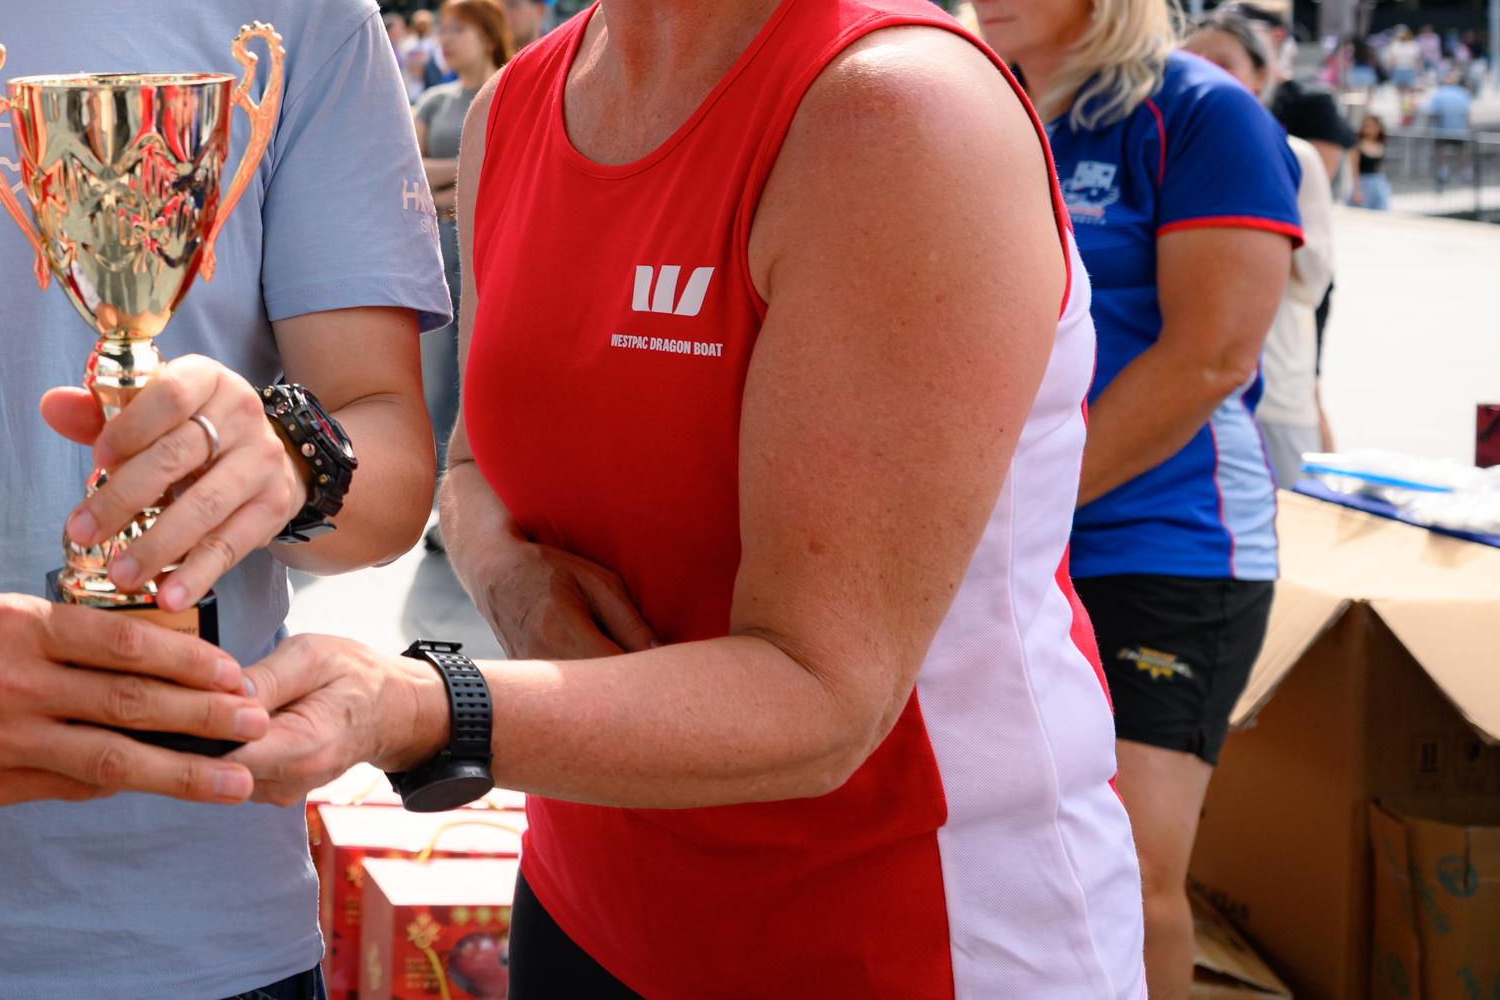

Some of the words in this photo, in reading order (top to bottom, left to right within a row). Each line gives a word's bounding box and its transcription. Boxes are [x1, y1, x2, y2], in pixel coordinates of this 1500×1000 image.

[611, 334, 649, 350] WESTPAC
[650, 337, 691, 355] DRAGON
[693, 342, 723, 357] BOAT
